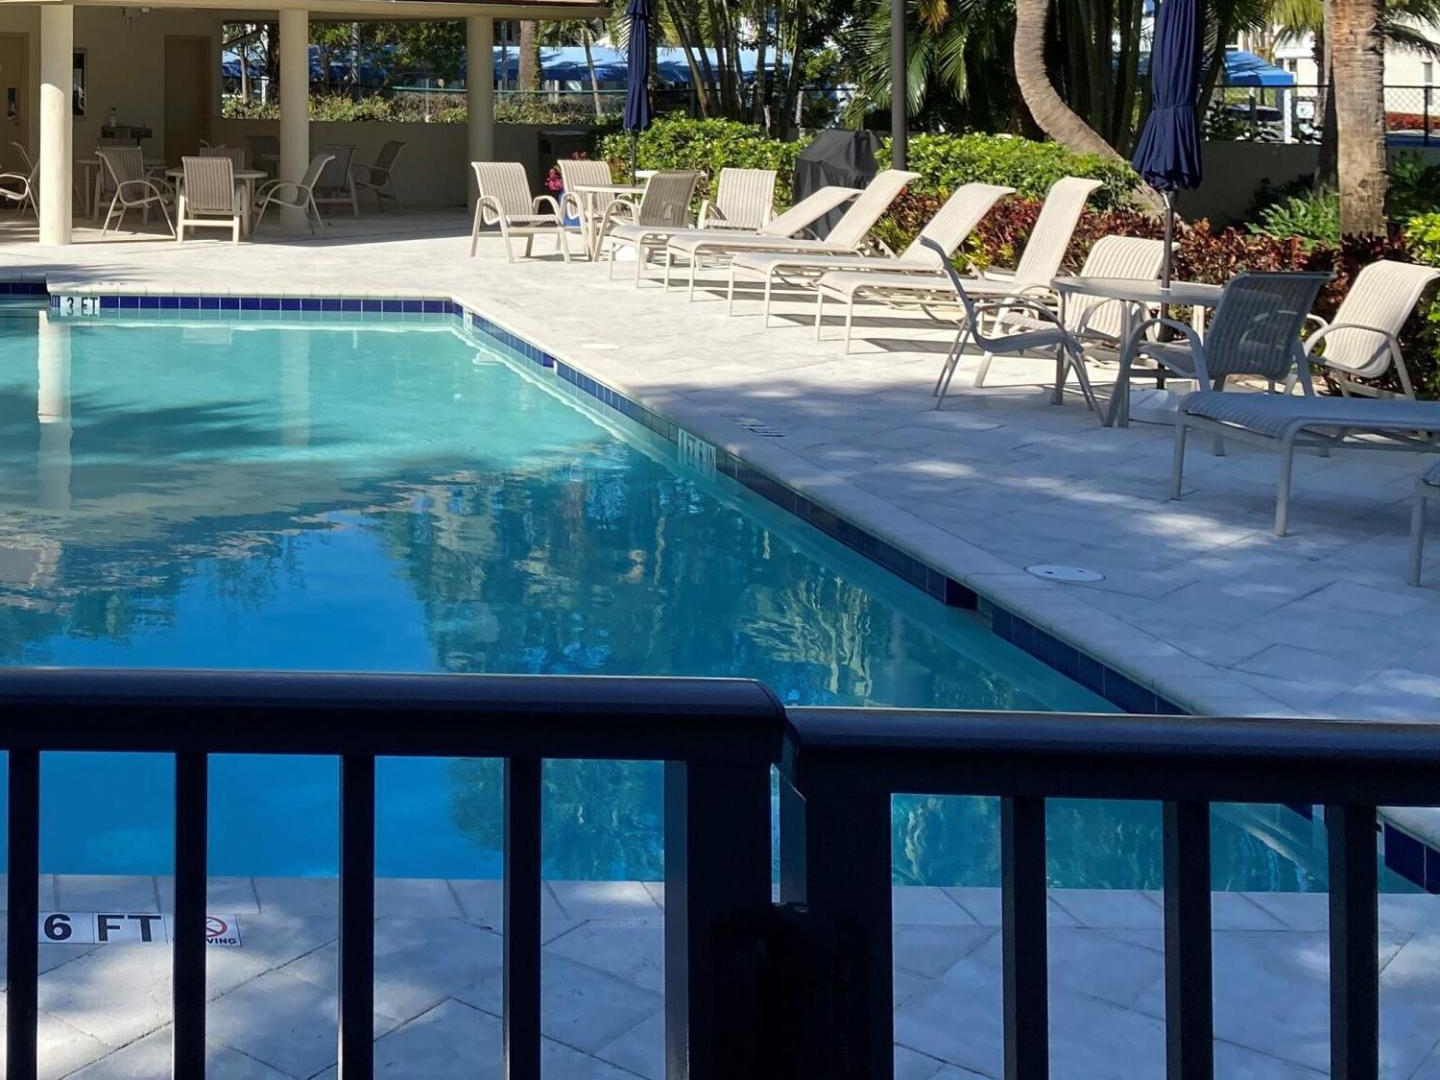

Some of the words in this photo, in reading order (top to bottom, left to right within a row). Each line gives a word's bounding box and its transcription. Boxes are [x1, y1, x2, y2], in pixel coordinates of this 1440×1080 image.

[44, 913, 72, 941] 6
[98, 914, 162, 942] FT
[206, 937, 237, 945] VING
